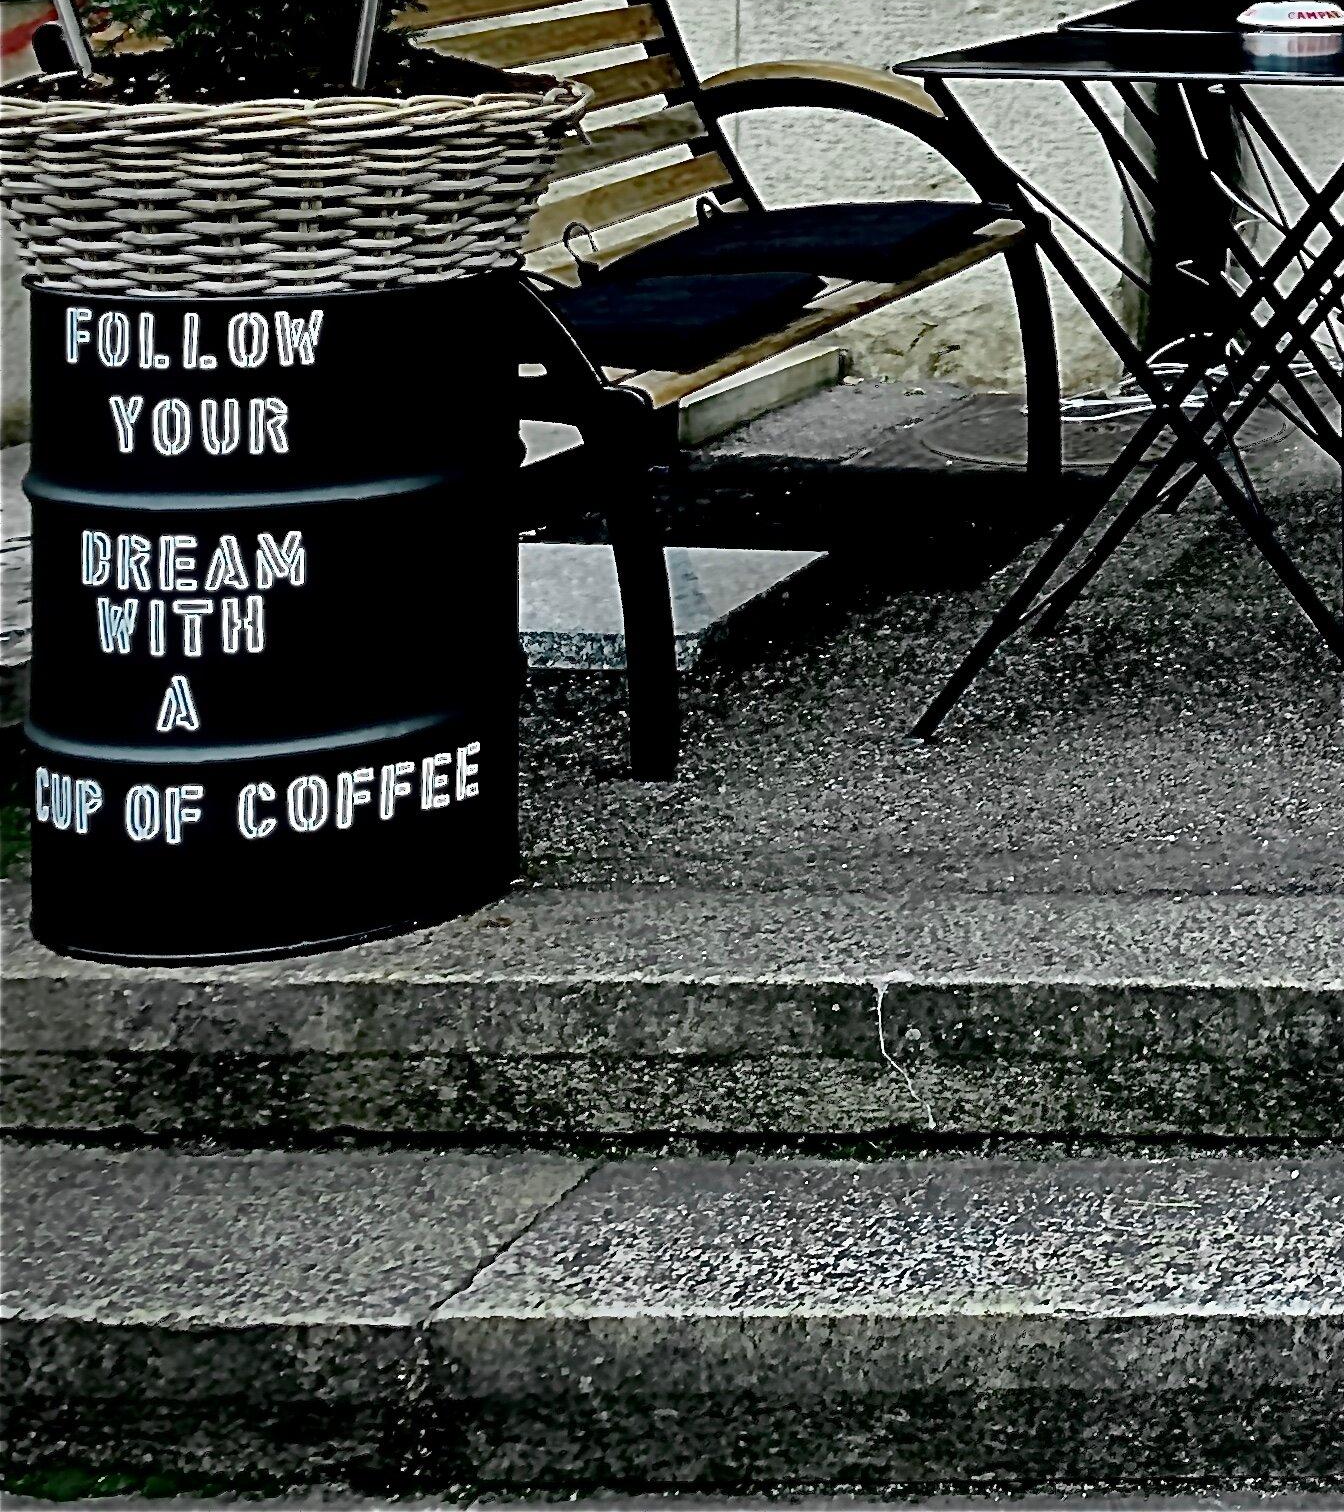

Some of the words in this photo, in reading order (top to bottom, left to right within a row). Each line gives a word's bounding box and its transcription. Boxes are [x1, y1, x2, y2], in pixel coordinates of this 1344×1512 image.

[65, 306, 325, 370] FOLLOW
[109, 395, 290, 455] YOUR
[81, 530, 308, 592] DREAM
[97, 594, 267, 657] WITH
[156, 675, 200, 732] A
[34, 766, 103, 834] CUP
[124, 782, 205, 845] OF
[237, 740, 482, 840] COFFEE
